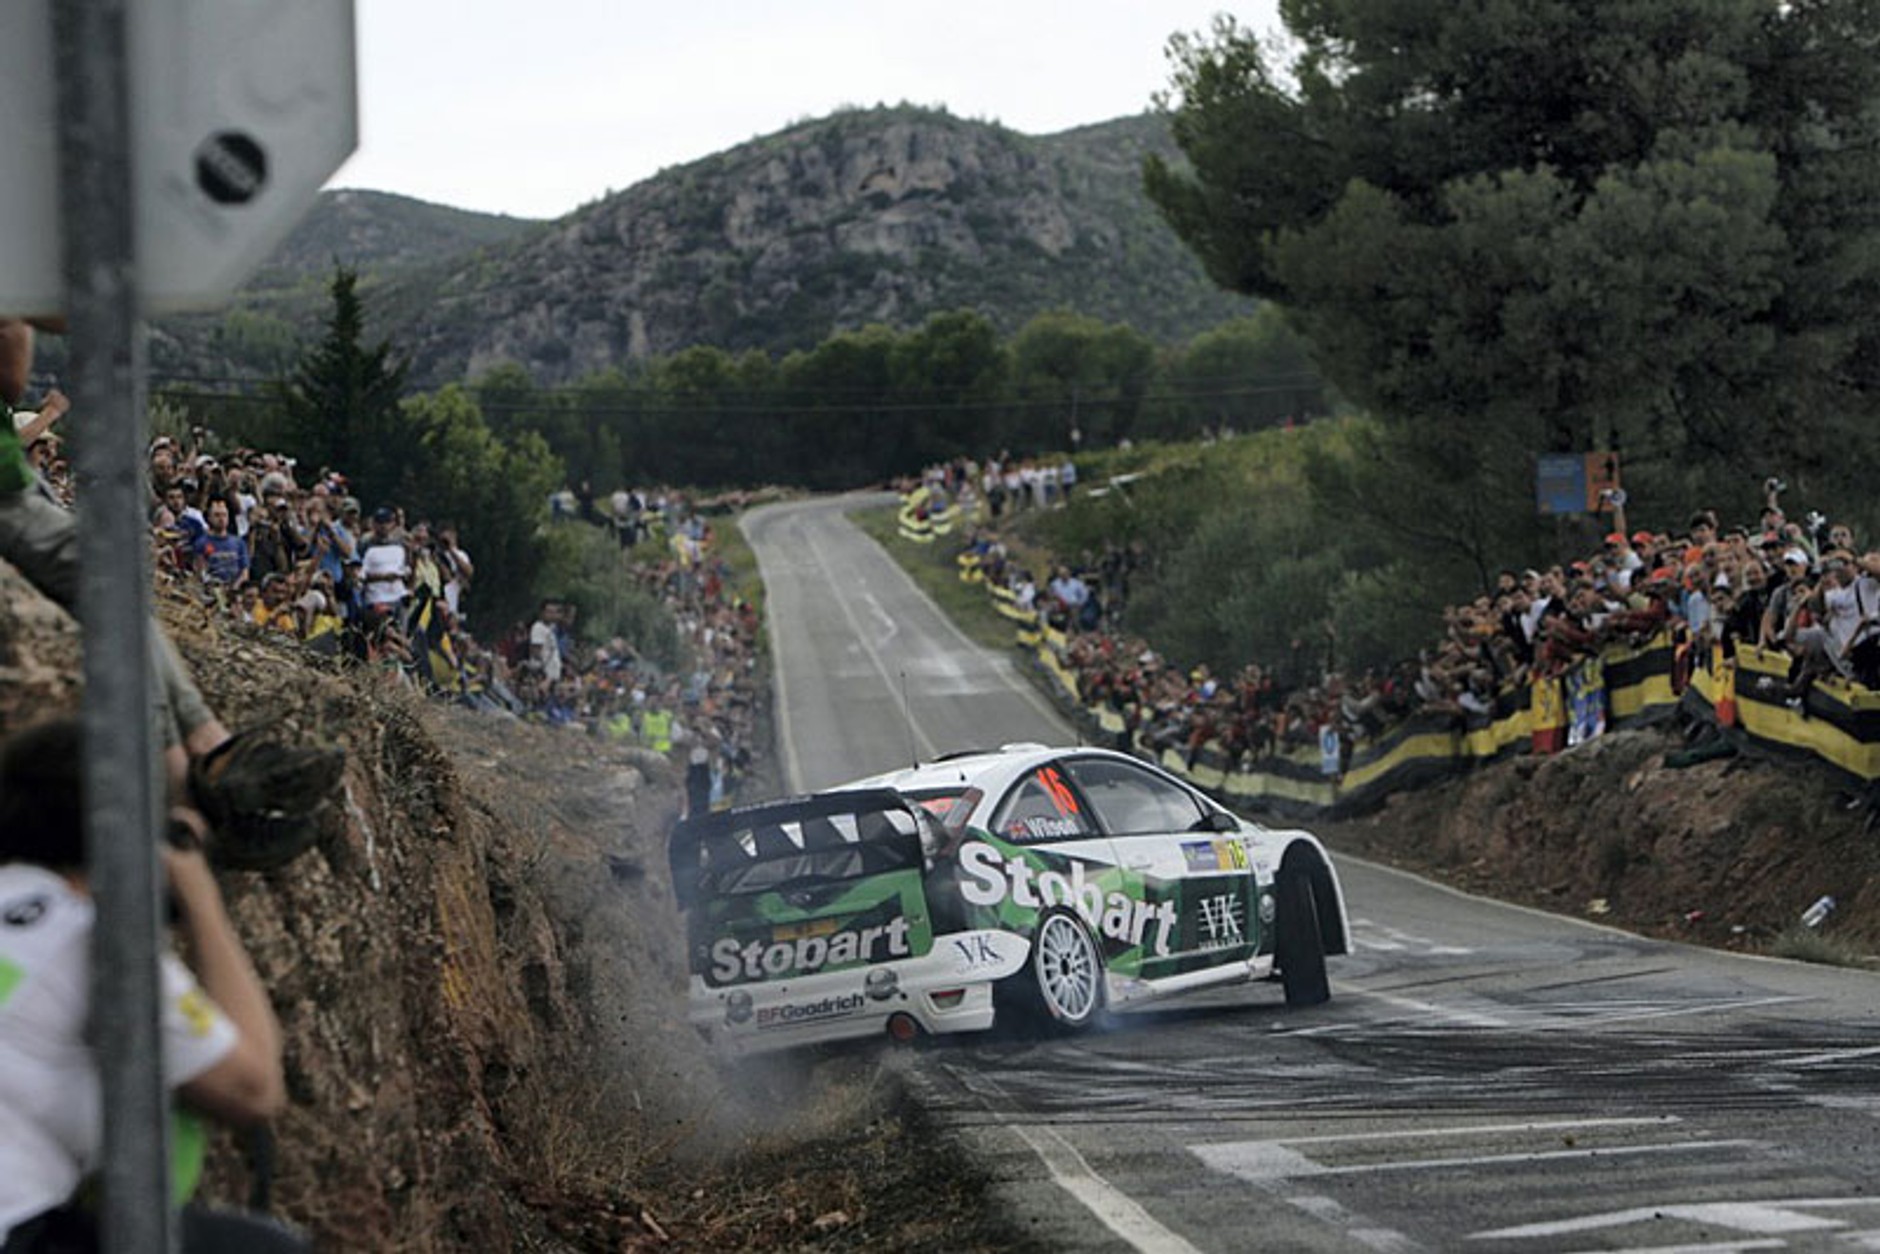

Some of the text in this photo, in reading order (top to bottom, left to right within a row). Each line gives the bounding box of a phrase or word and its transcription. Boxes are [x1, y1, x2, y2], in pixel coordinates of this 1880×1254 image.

[1036, 767, 1078, 817] 16
[959, 841, 1177, 957] Stobart
[1200, 893, 1240, 938] VK
[711, 916, 910, 982] Stobart
[954, 933, 1004, 963] VK
[757, 993, 864, 1023] BFGoodrich
